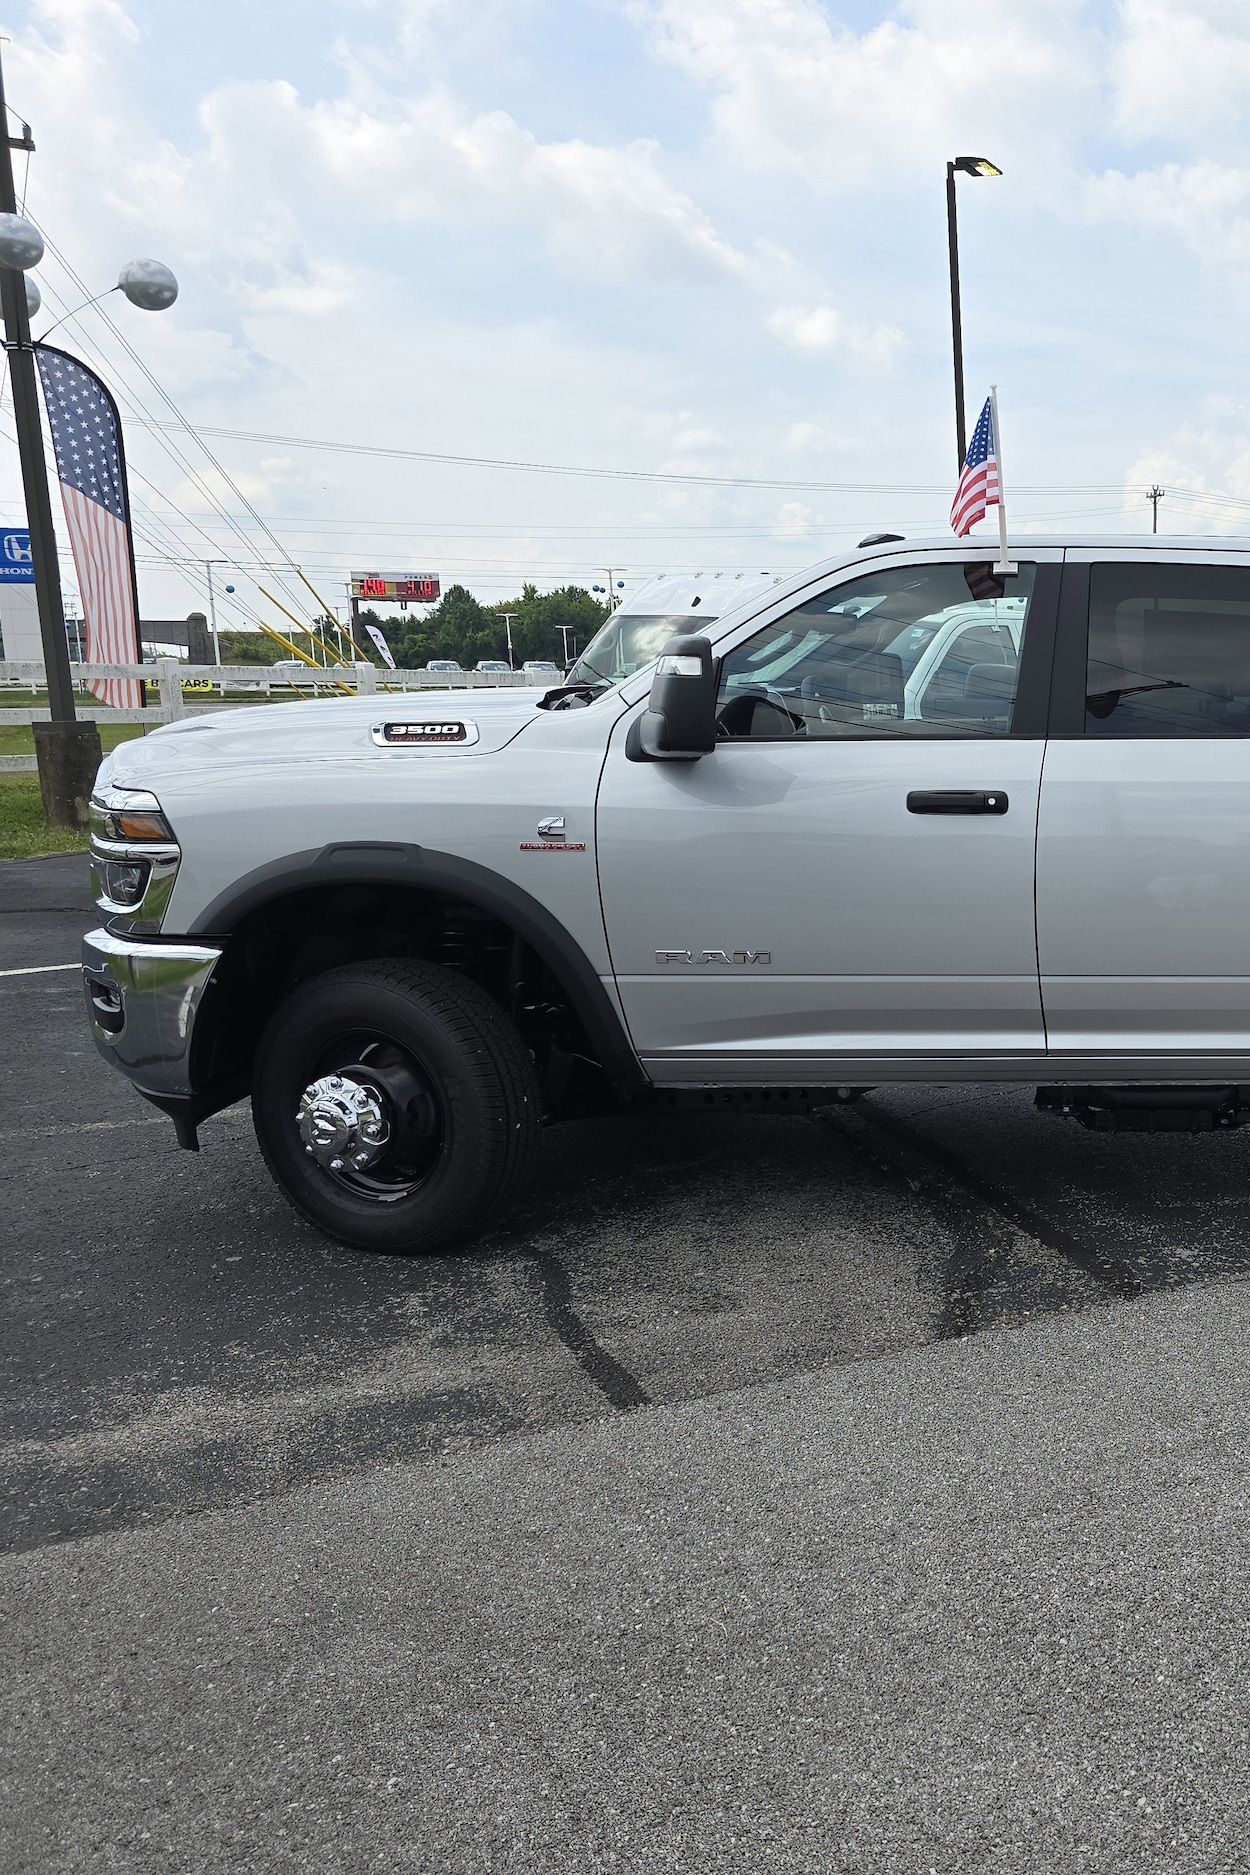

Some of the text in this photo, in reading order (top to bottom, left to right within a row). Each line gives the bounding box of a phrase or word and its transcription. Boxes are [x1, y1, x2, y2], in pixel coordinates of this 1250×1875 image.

[0, 567, 35, 575] HON
[389, 725, 460, 735] 3500
[655, 949, 772, 965] RAM
